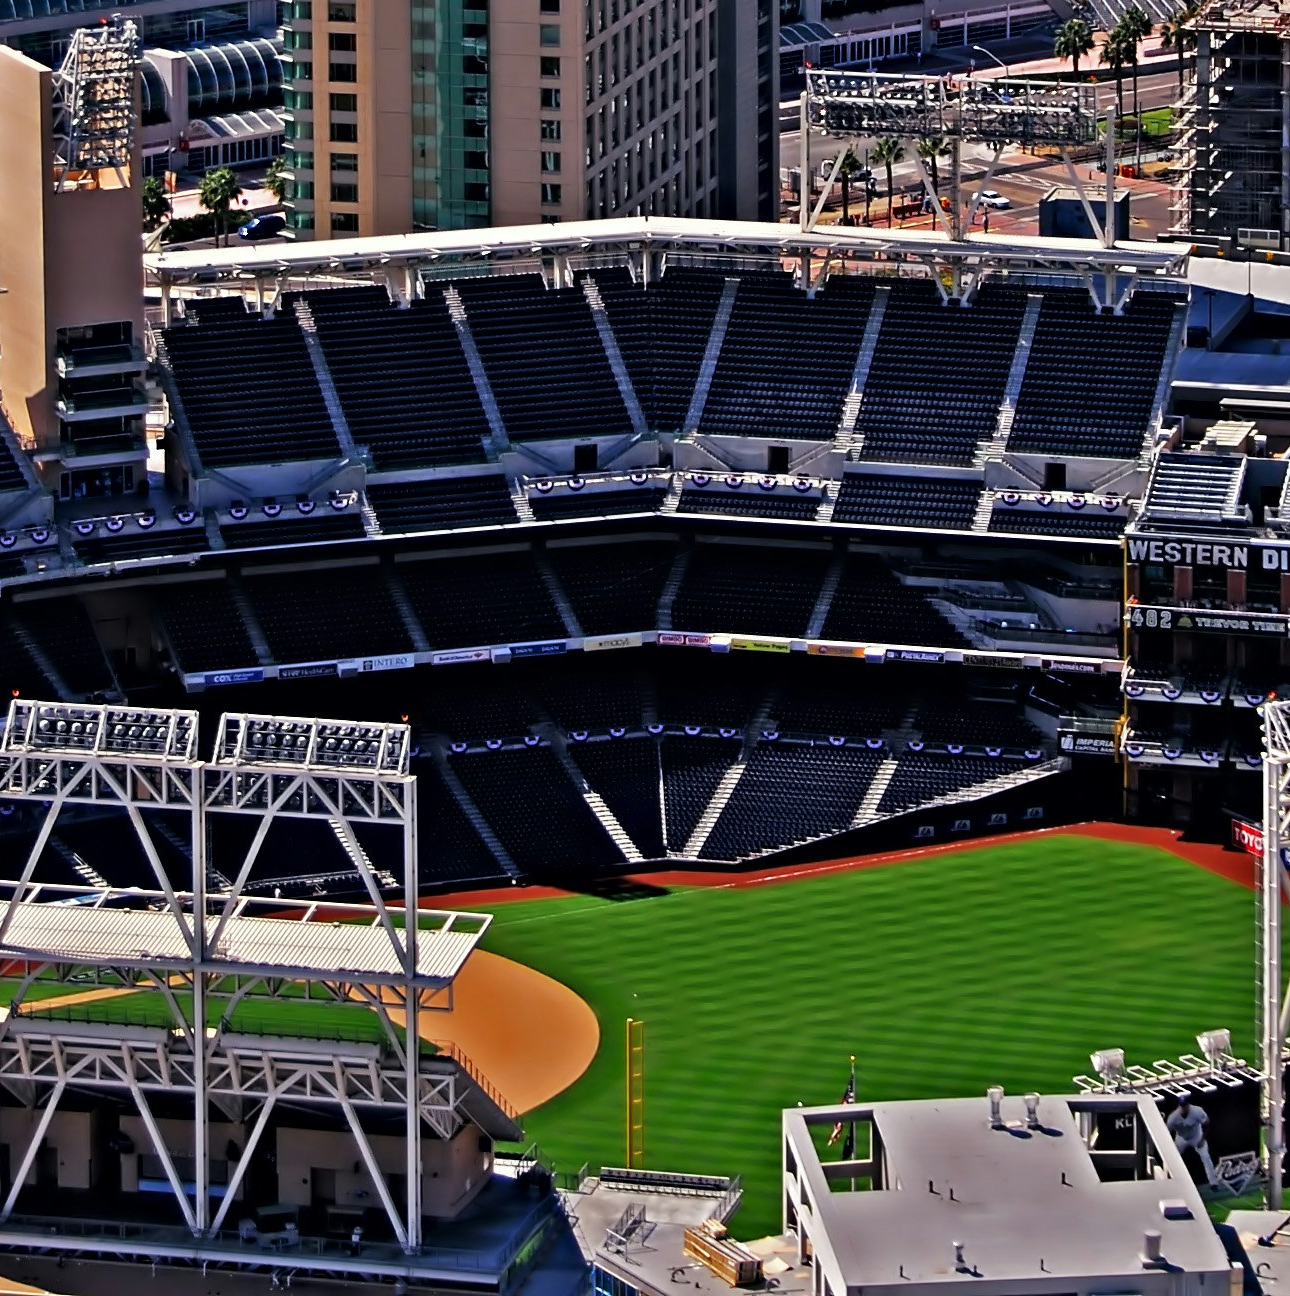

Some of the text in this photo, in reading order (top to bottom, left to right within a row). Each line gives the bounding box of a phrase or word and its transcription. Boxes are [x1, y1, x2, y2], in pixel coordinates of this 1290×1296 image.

[1128, 539, 1248, 567] WESTERN
[1076, 737, 1114, 747] IMPERIA
[1234, 825, 1264, 852] TOYO
